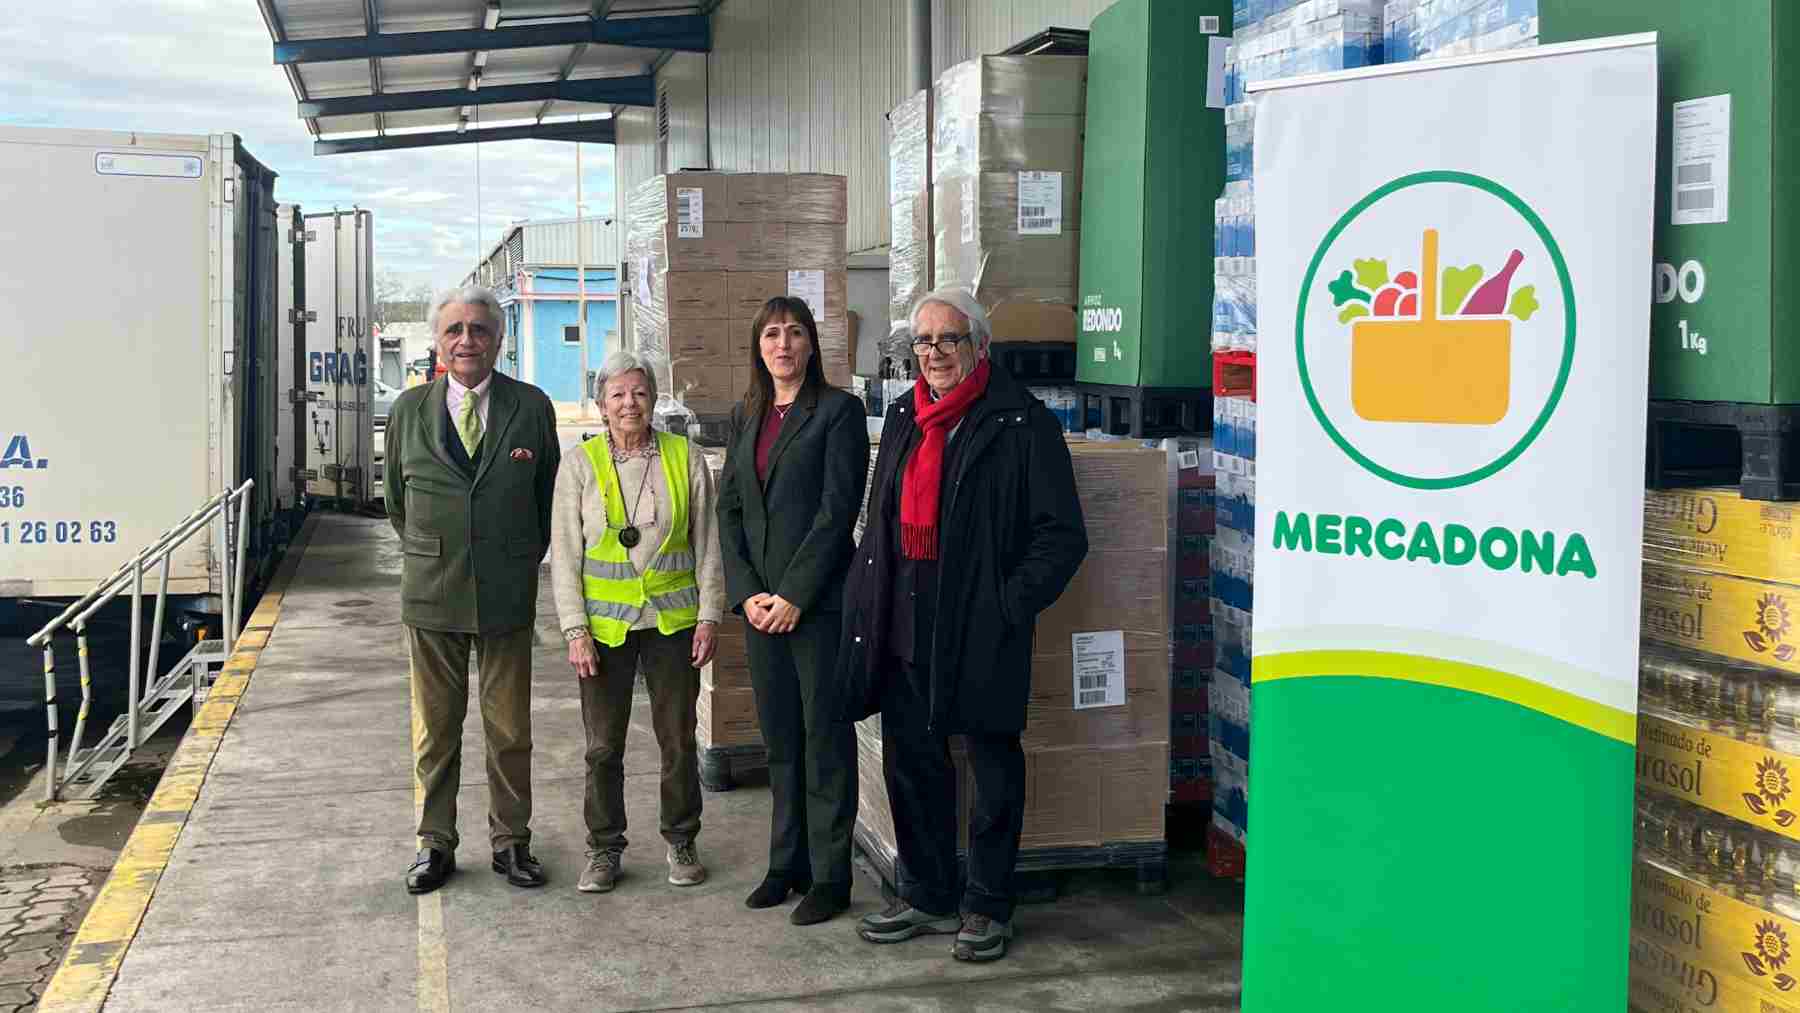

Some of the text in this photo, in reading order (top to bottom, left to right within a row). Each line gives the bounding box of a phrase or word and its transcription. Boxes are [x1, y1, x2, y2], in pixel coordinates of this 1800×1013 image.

[0, 486, 24, 508] 36
[20, 521, 47, 544] 26
[56, 521, 82, 544] 02
[90, 520, 117, 544] 63
[1273, 510, 1597, 579] MERCADONA
[1696, 737, 1712, 758] de
[1695, 892, 1712, 913] de
